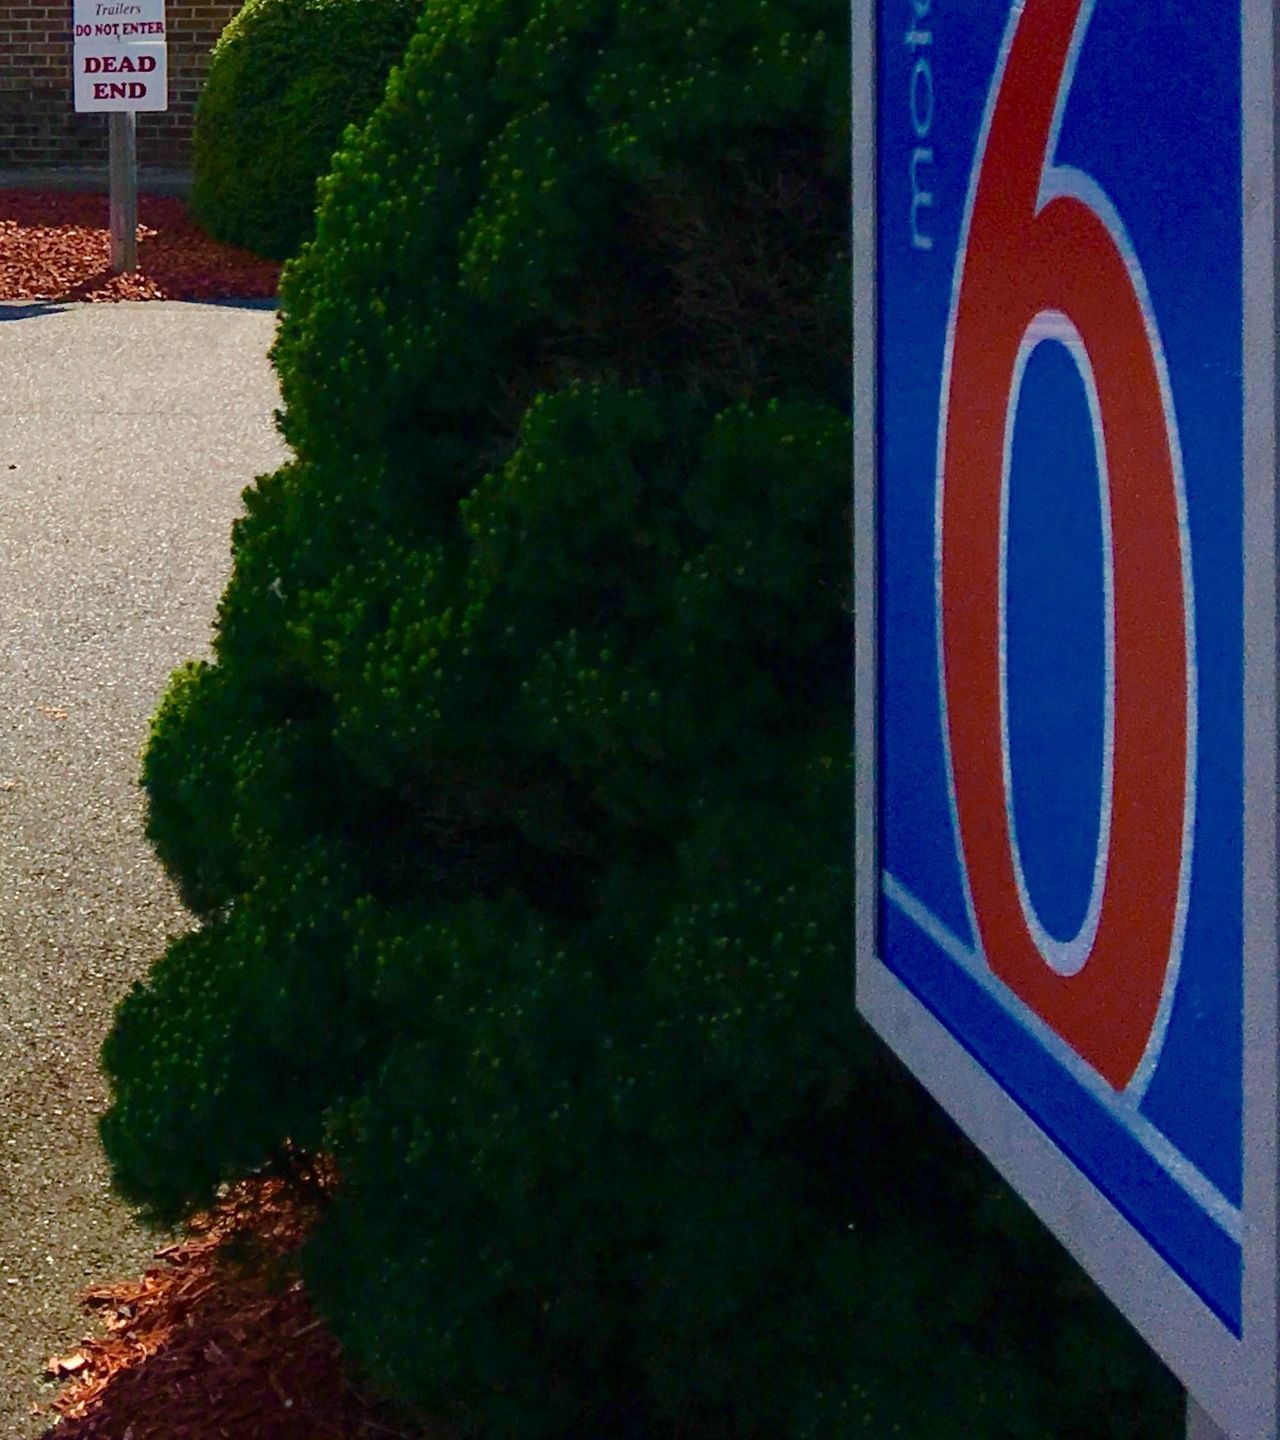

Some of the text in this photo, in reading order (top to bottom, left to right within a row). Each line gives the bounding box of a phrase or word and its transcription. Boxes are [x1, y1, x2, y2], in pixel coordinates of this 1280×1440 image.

[96, 3, 141, 16] Trailers
[76, 22, 164, 36] DO NOT ENTER
[84, 56, 156, 73] DEAD
[93, 83, 146, 99] END
